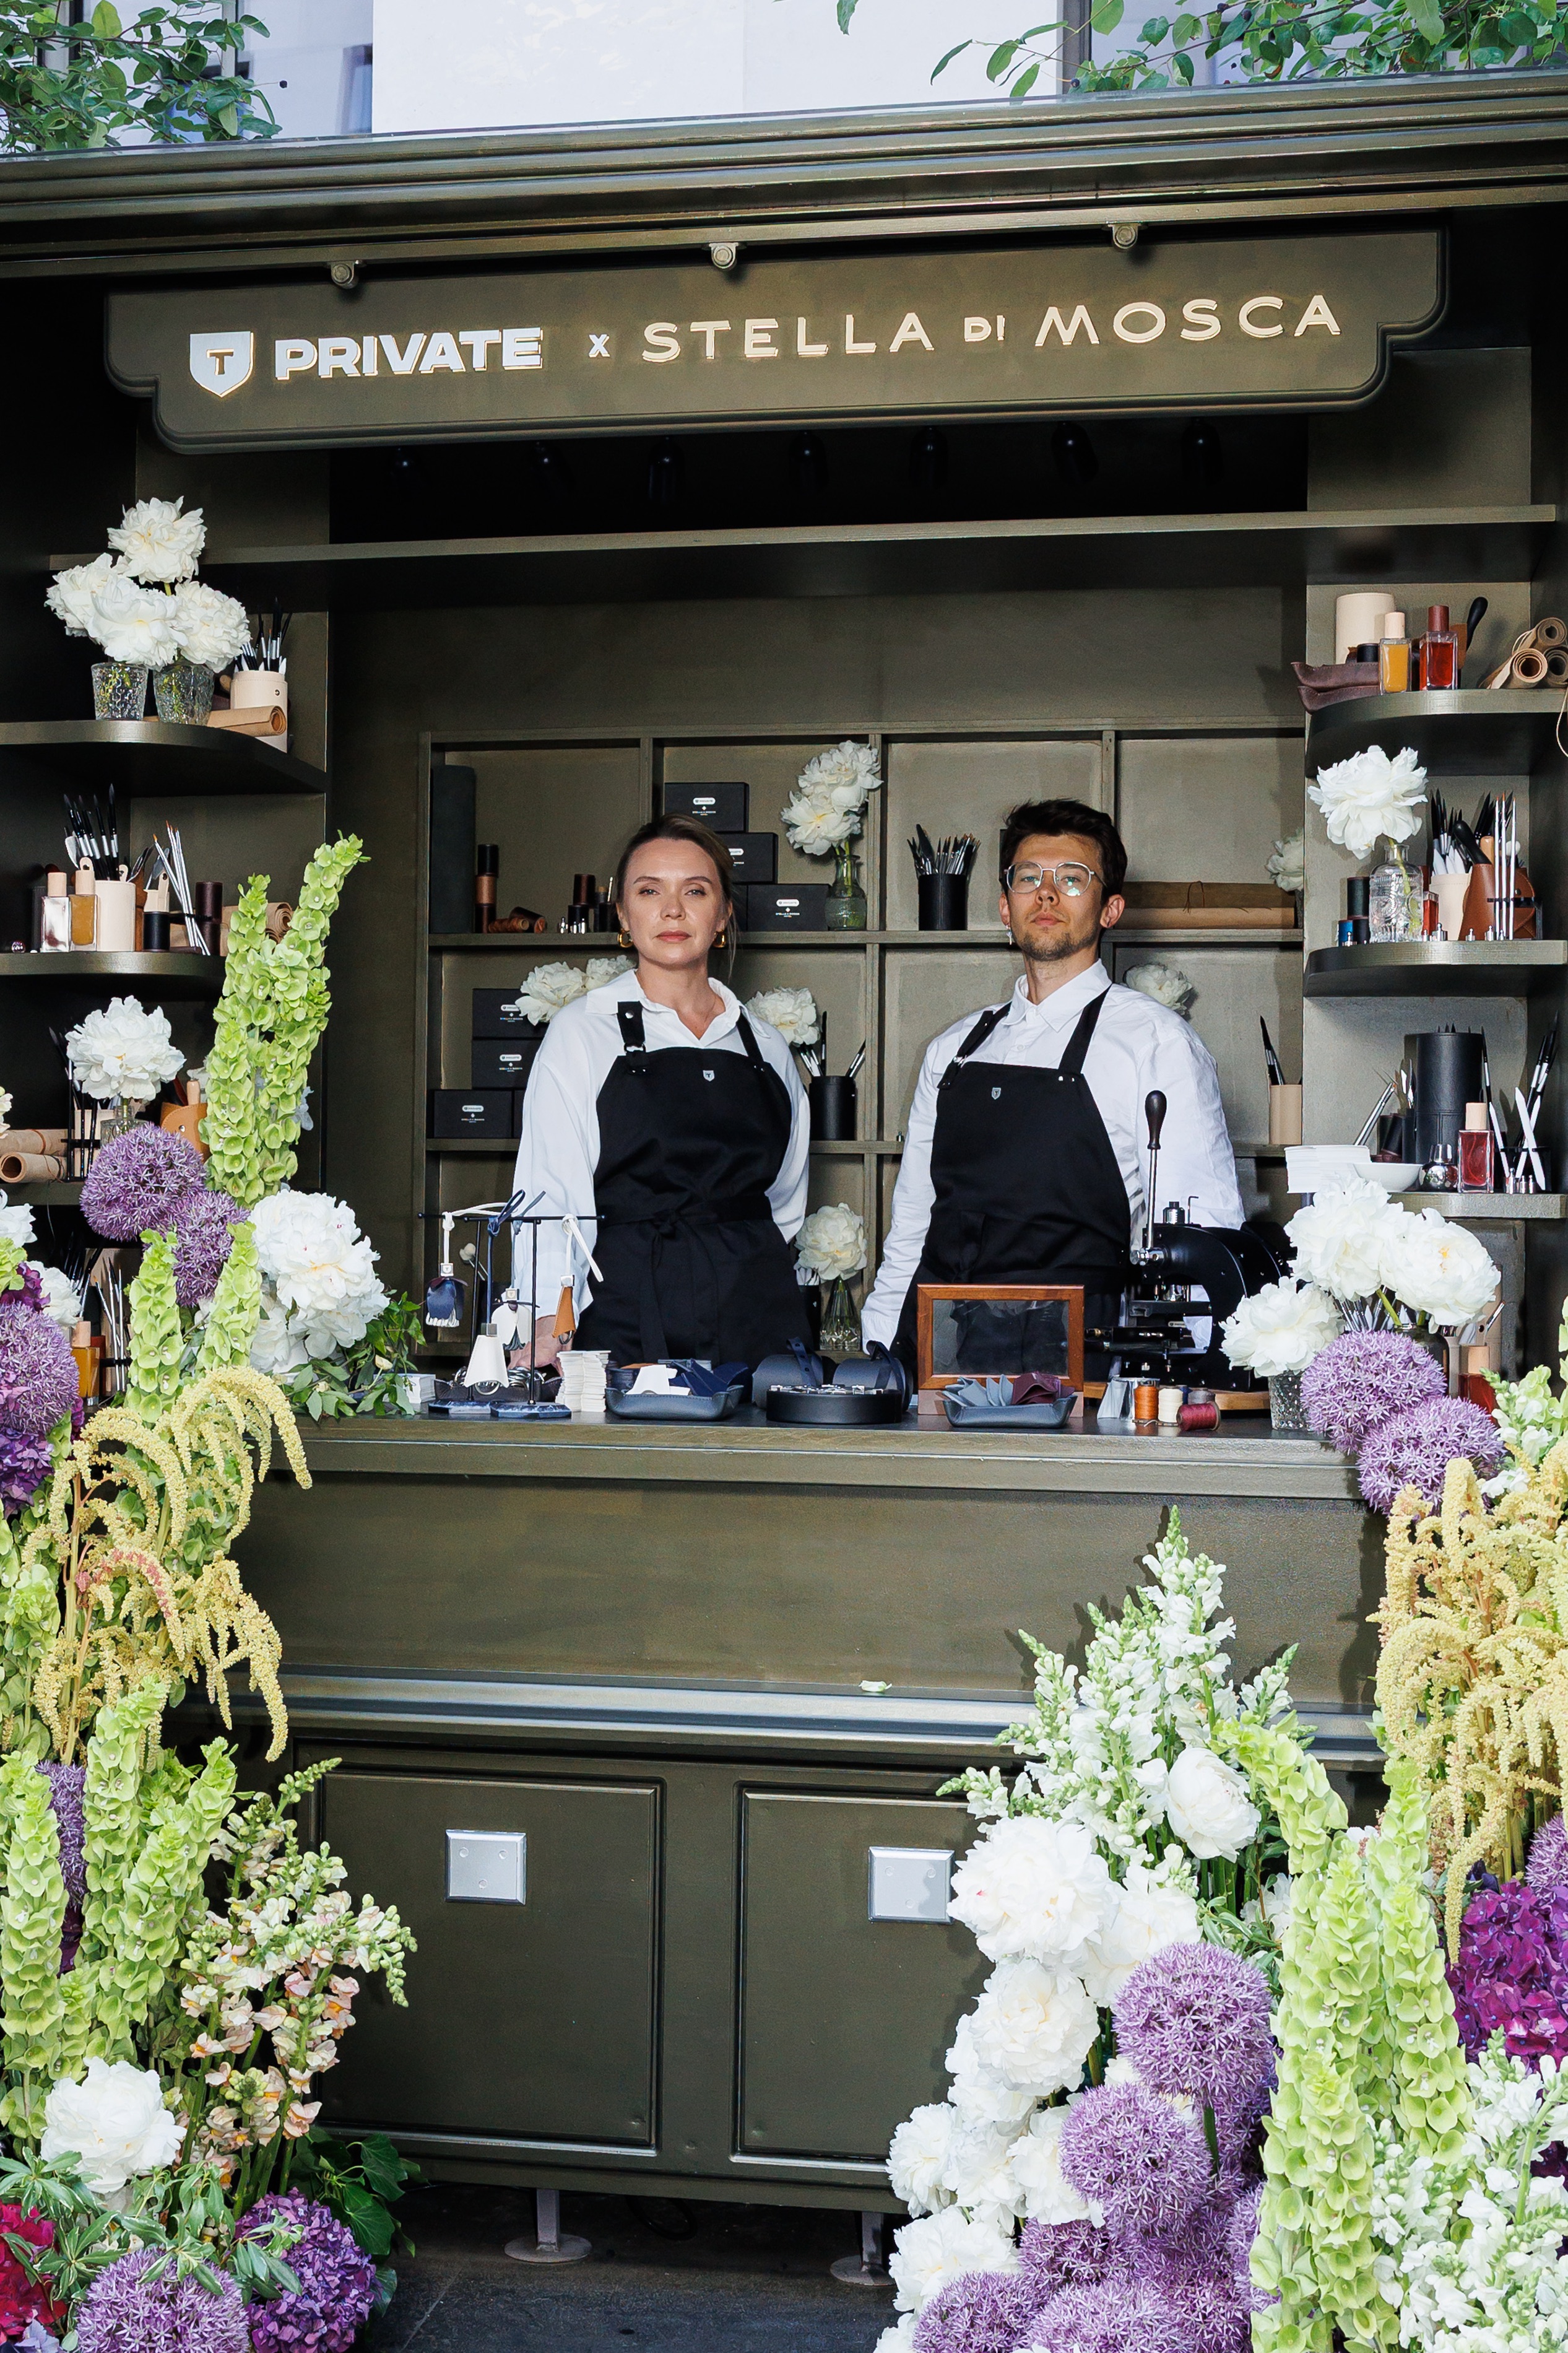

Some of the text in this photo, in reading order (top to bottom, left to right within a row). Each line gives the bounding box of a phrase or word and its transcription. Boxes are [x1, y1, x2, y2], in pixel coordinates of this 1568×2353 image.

[207, 349, 234, 376] T
[275, 327, 544, 381] PRIVATE
[641, 312, 935, 363] STELLA
[964, 315, 1006, 342] DI
[1034, 295, 1341, 347] MOSCA
